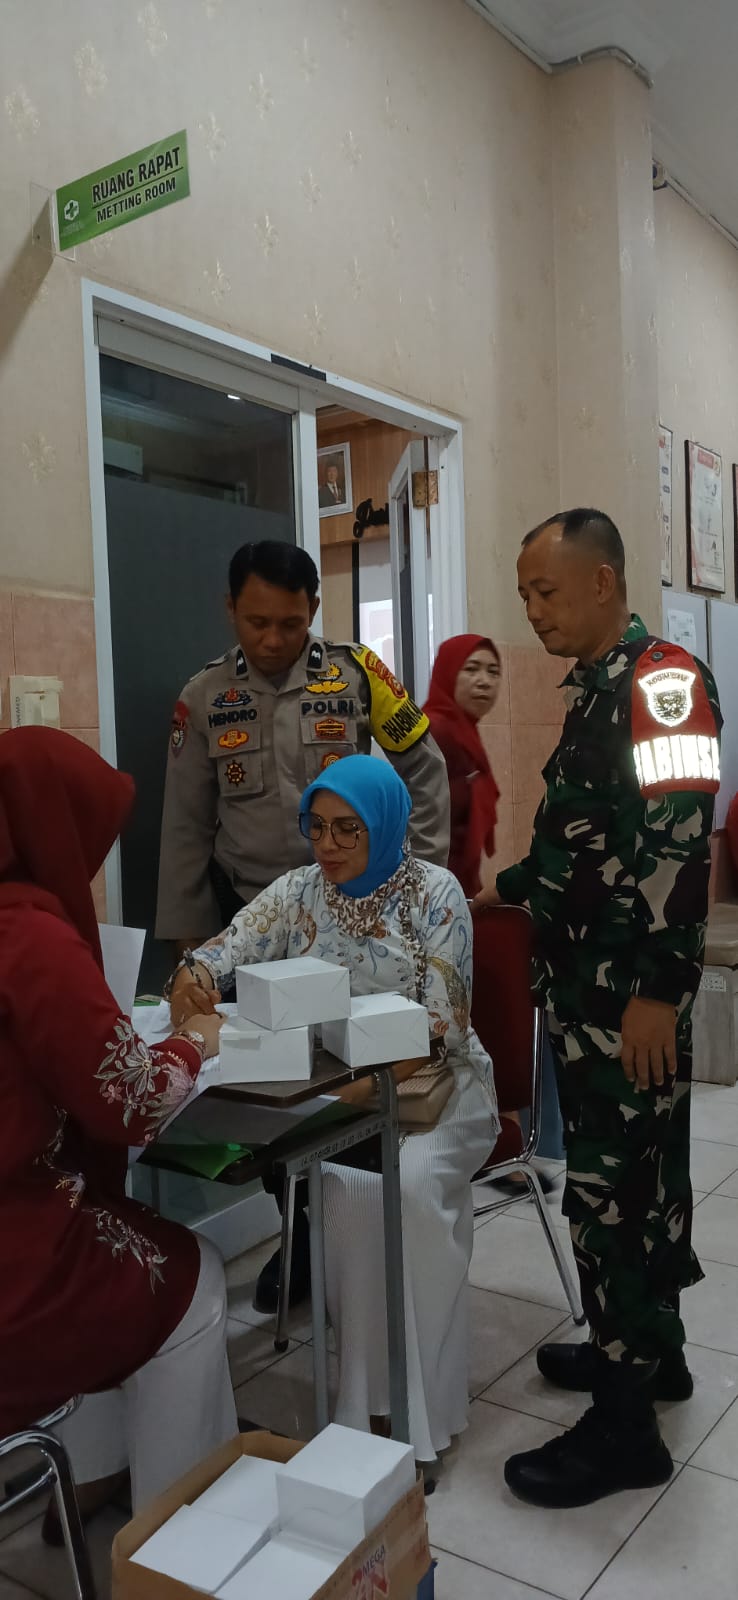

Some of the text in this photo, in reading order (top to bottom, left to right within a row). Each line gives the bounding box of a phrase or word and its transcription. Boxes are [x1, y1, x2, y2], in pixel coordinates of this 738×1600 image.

[92, 146, 180, 203] RUANG RAPAT
[97, 177, 176, 223] METTING ROOM
[208, 707, 258, 729] HENDRO
[301, 700, 354, 716] POLRI
[362, 1544, 386, 1577] MEGA
